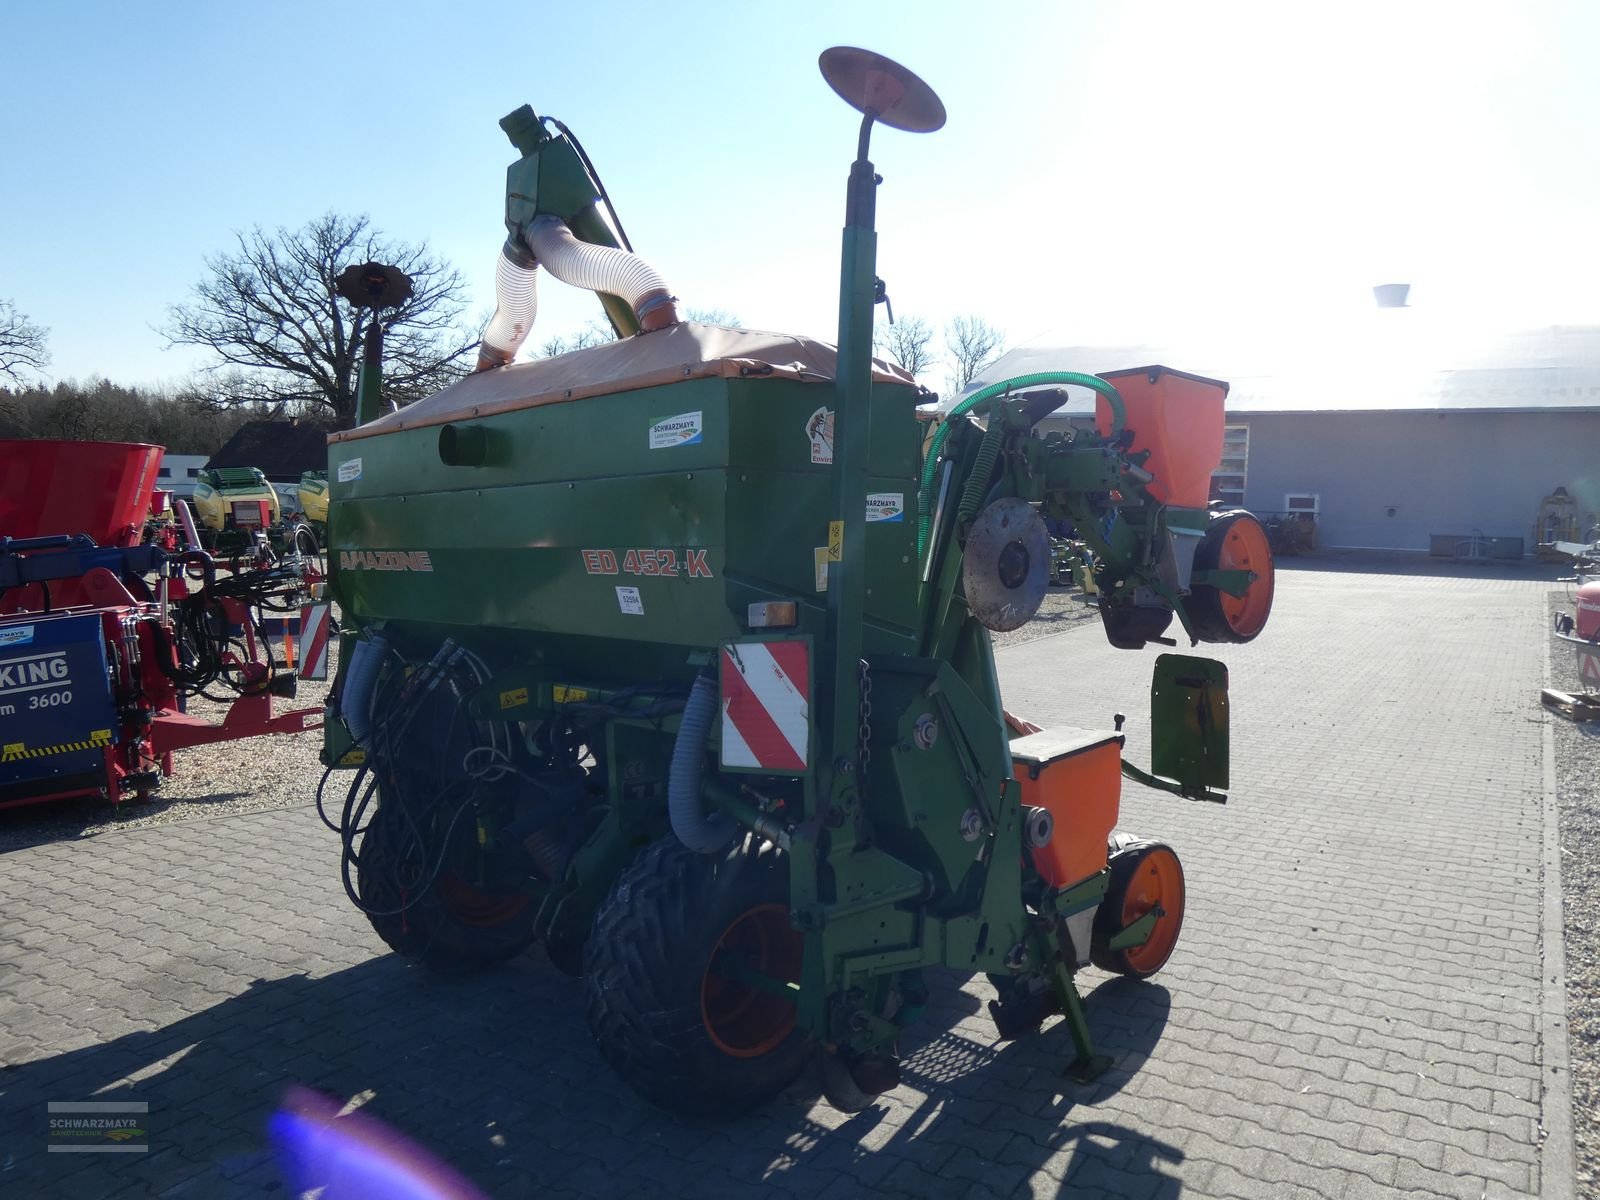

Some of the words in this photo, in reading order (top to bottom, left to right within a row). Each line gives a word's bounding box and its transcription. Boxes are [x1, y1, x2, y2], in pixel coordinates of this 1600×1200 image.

[654, 420, 695, 433] SCHWARZMAYR
[340, 551, 434, 572] AMAZONE
[581, 549, 619, 575] ED
[622, 549, 678, 577] 452
[686, 549, 714, 578] K
[0, 658, 69, 688] KING
[28, 691, 73, 710] 3600
